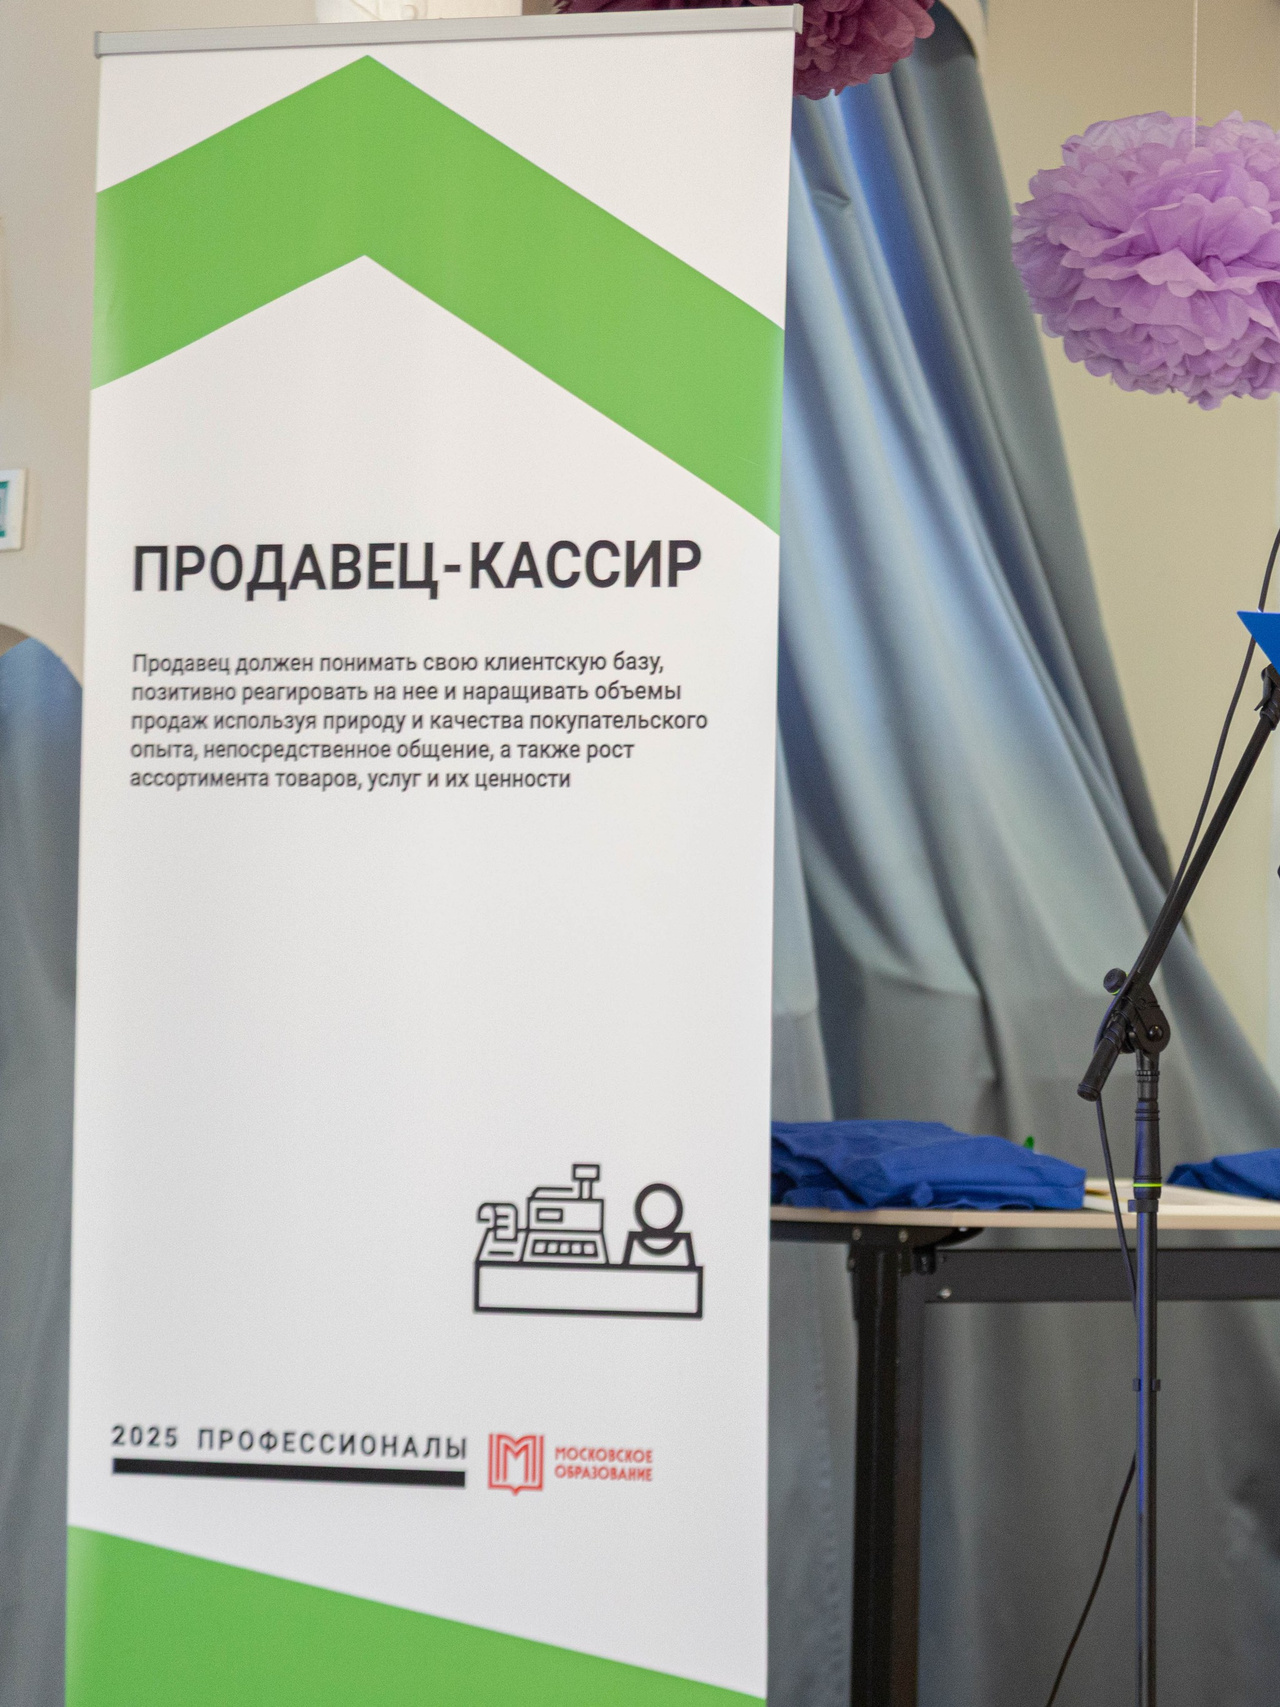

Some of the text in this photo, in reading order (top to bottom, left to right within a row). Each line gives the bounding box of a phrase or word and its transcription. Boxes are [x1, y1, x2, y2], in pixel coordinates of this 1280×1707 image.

[133, 540, 702, 601] ПРОДАВЕЦ-КАССИР
[133, 650, 664, 676] Продавец должен понимать свою клиентскую базу,
[132, 679, 681, 705] позитивно реагировать на нее и наращивать объемы
[131, 714, 708, 735] продаж используя природу и качества покупательского
[130, 738, 635, 764] опыта, непосредственное общение, а также рост
[130, 771, 571, 793] ассортимента товаров, услуг и их ценности
[111, 1425, 467, 1460] 2025 ПРОФЕССИОНАЛЫ
[554, 1446, 653, 1464] МОСКОВСКОЕ
[554, 1463, 653, 1482] ОБРАЗОВАНИЕ
